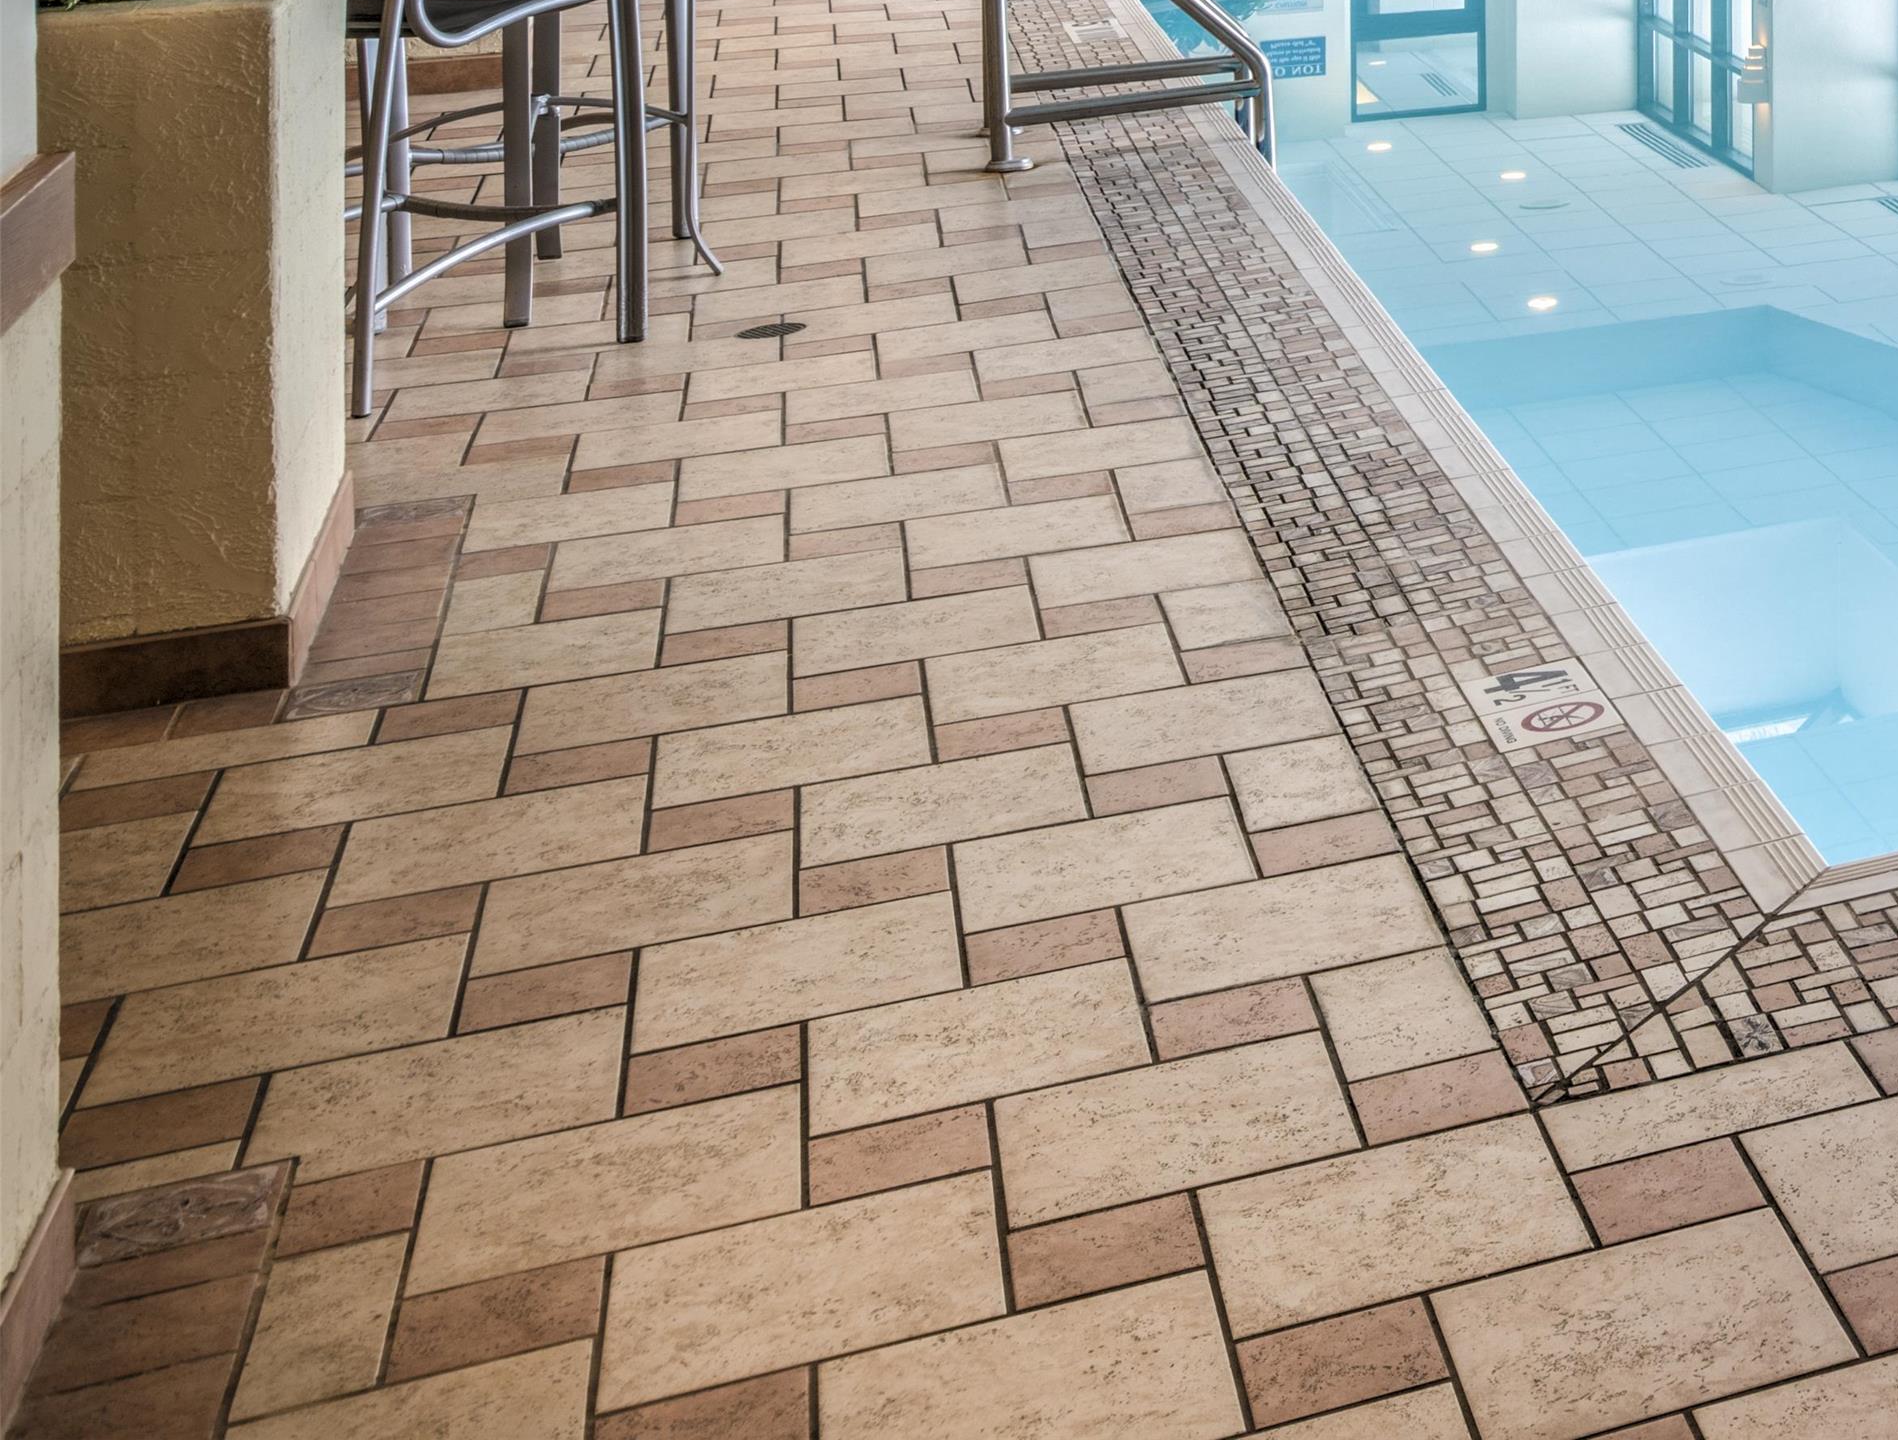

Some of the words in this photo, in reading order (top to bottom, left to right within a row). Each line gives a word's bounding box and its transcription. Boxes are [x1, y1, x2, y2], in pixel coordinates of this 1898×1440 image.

[1483, 670, 1568, 694] 4
[1495, 717, 1507, 726] NO
[1498, 725, 1518, 744] DIVING
